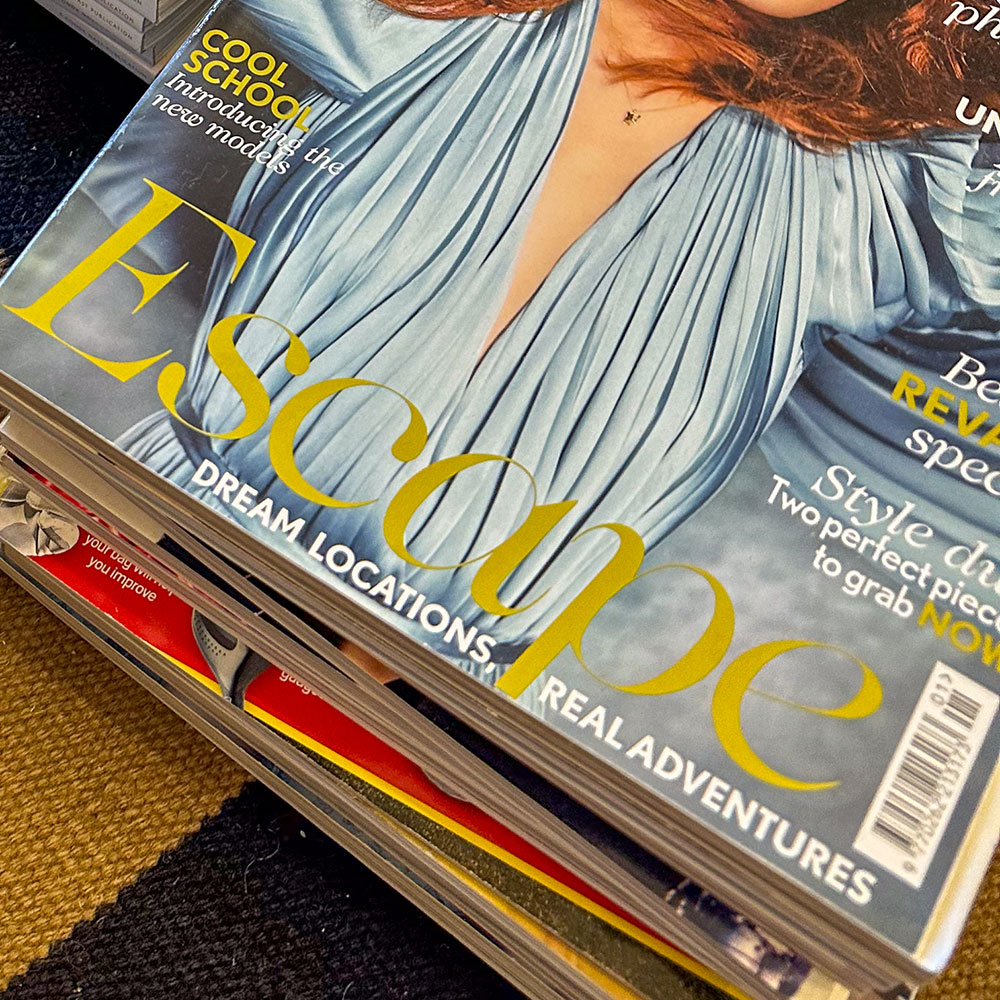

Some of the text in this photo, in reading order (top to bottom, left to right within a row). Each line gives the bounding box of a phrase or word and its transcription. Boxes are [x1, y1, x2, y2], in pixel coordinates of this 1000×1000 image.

[182, 49, 312, 133] SCHOOL
[202, 29, 289, 88] COOL
[151, 93, 291, 175] new models
[164, 71, 346, 176] Introducing the
[1, 178, 884, 791] Escape
[811, 464, 934, 549] Style
[82, 534, 110, 555] your
[767, 474, 821, 526] Two
[819, 516, 933, 588] perfect
[86, 556, 111, 575] you
[110, 567, 157, 602] improve
[812, 545, 843, 578] to
[841, 569, 914, 619] grab
[191, 458, 879, 906] DREAM LOCATIONS, REAL ADVENTURES
